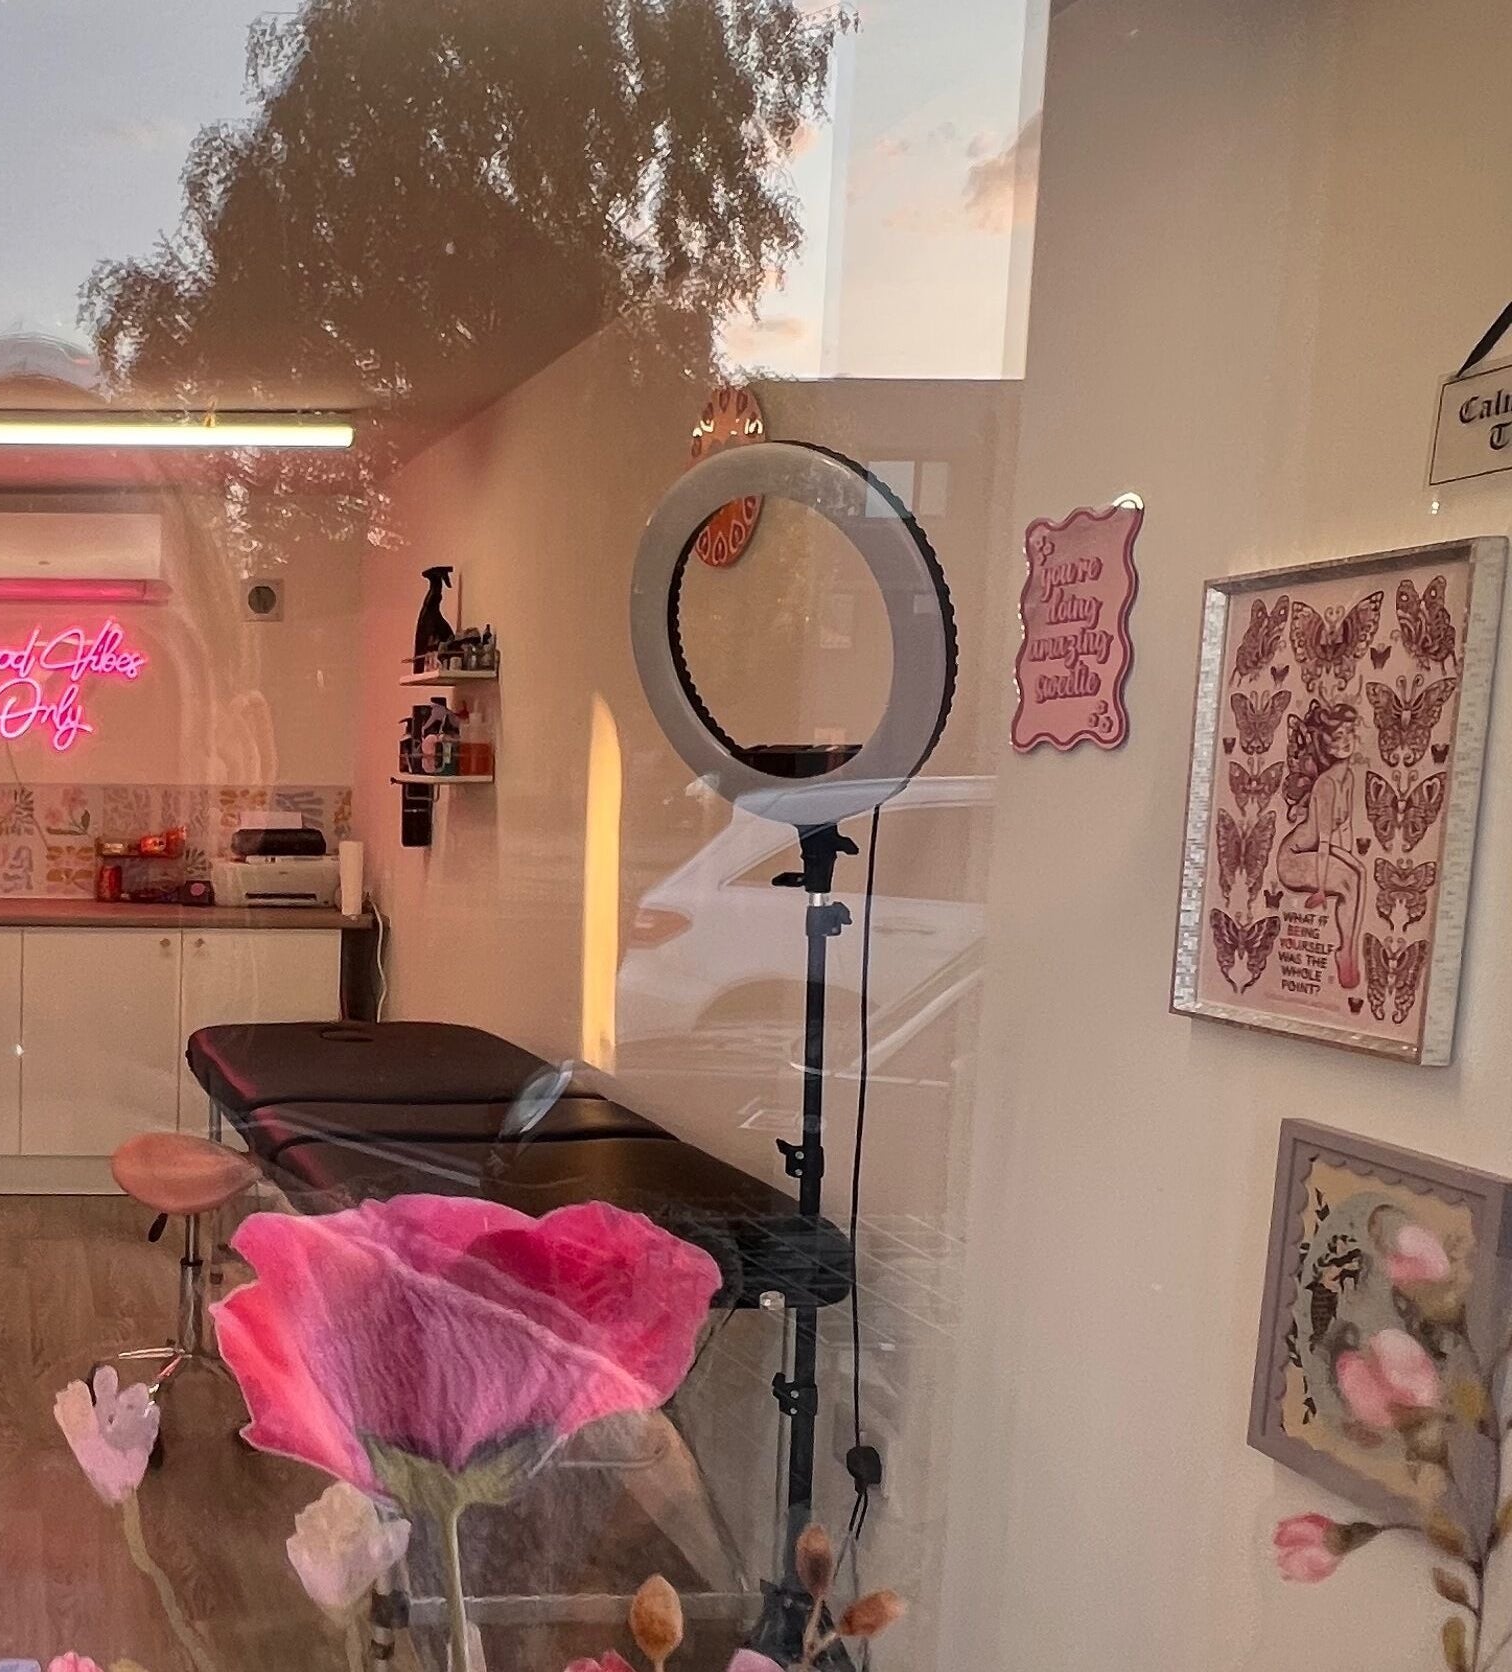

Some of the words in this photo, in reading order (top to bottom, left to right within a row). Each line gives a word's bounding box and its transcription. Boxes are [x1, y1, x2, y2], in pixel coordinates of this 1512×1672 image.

[1046, 587, 1104, 630] doing
[39, 616, 147, 681] Vibes
[1028, 627, 1115, 669] amazing
[1282, 911, 1316, 925] WHAT
[1287, 924, 1320, 940] BEING
[1279, 937, 1334, 955] YOURSELF
[1278, 950, 1302, 965] WAS
[1306, 954, 1328, 969] THE
[1280, 965, 1322, 982] WHOLE
[1281, 979, 1322, 995] POINT?
